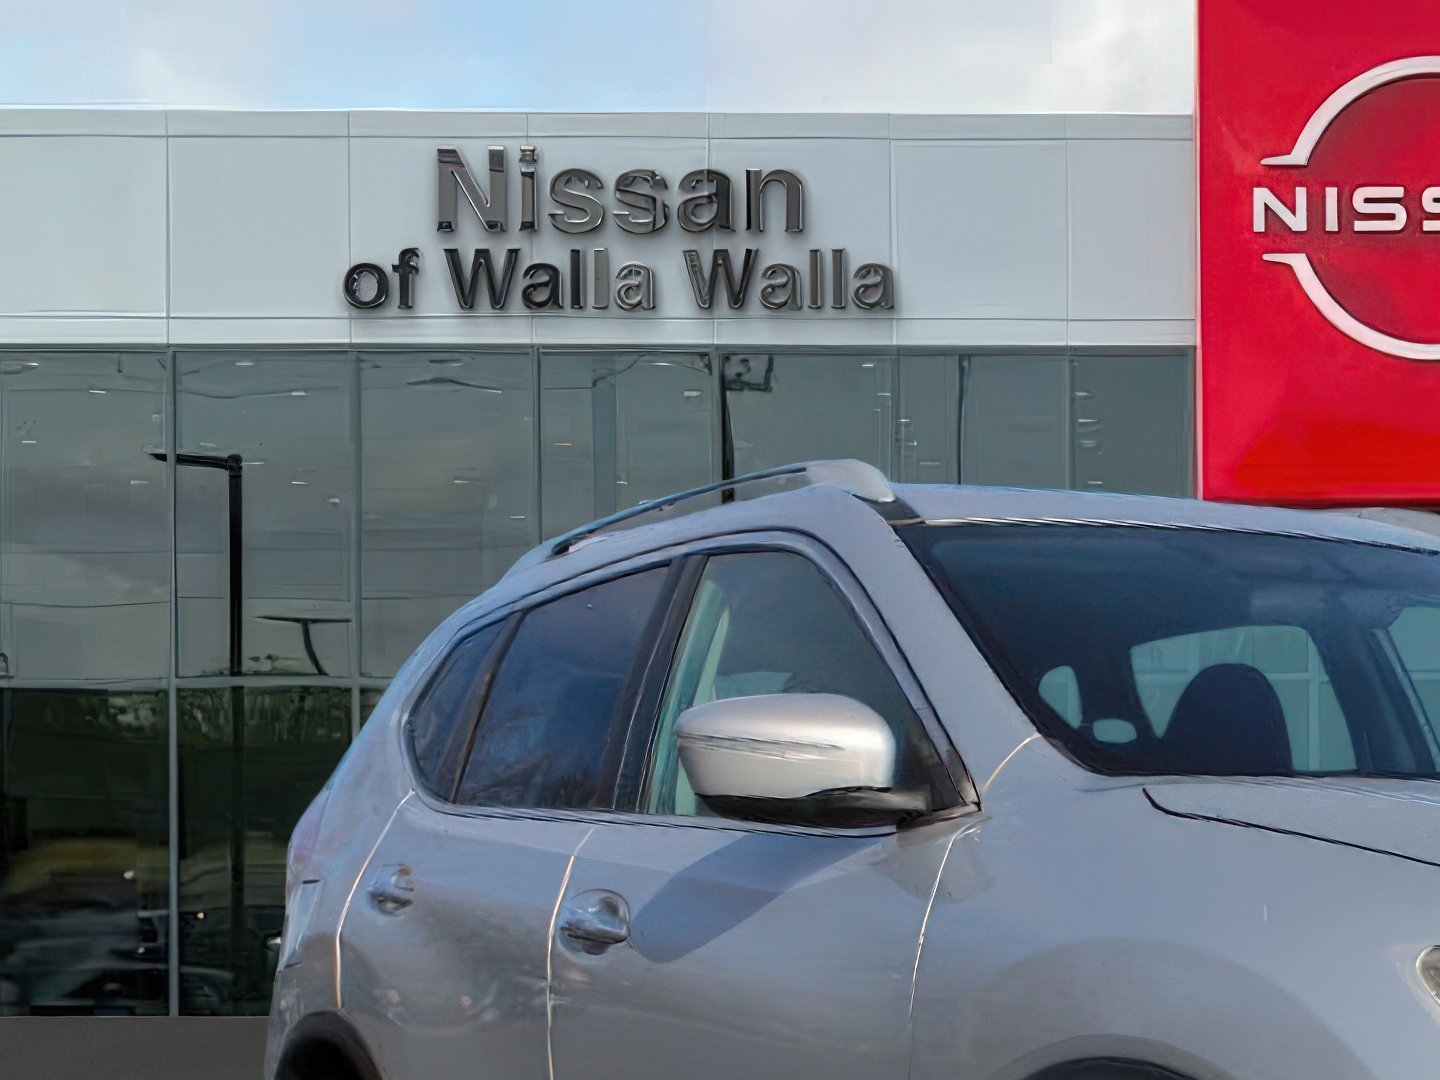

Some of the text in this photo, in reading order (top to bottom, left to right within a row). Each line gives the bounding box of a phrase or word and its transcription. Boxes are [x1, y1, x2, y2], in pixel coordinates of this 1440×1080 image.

[436, 145, 805, 234] Nissan
[343, 247, 895, 311] of Walla Walla
